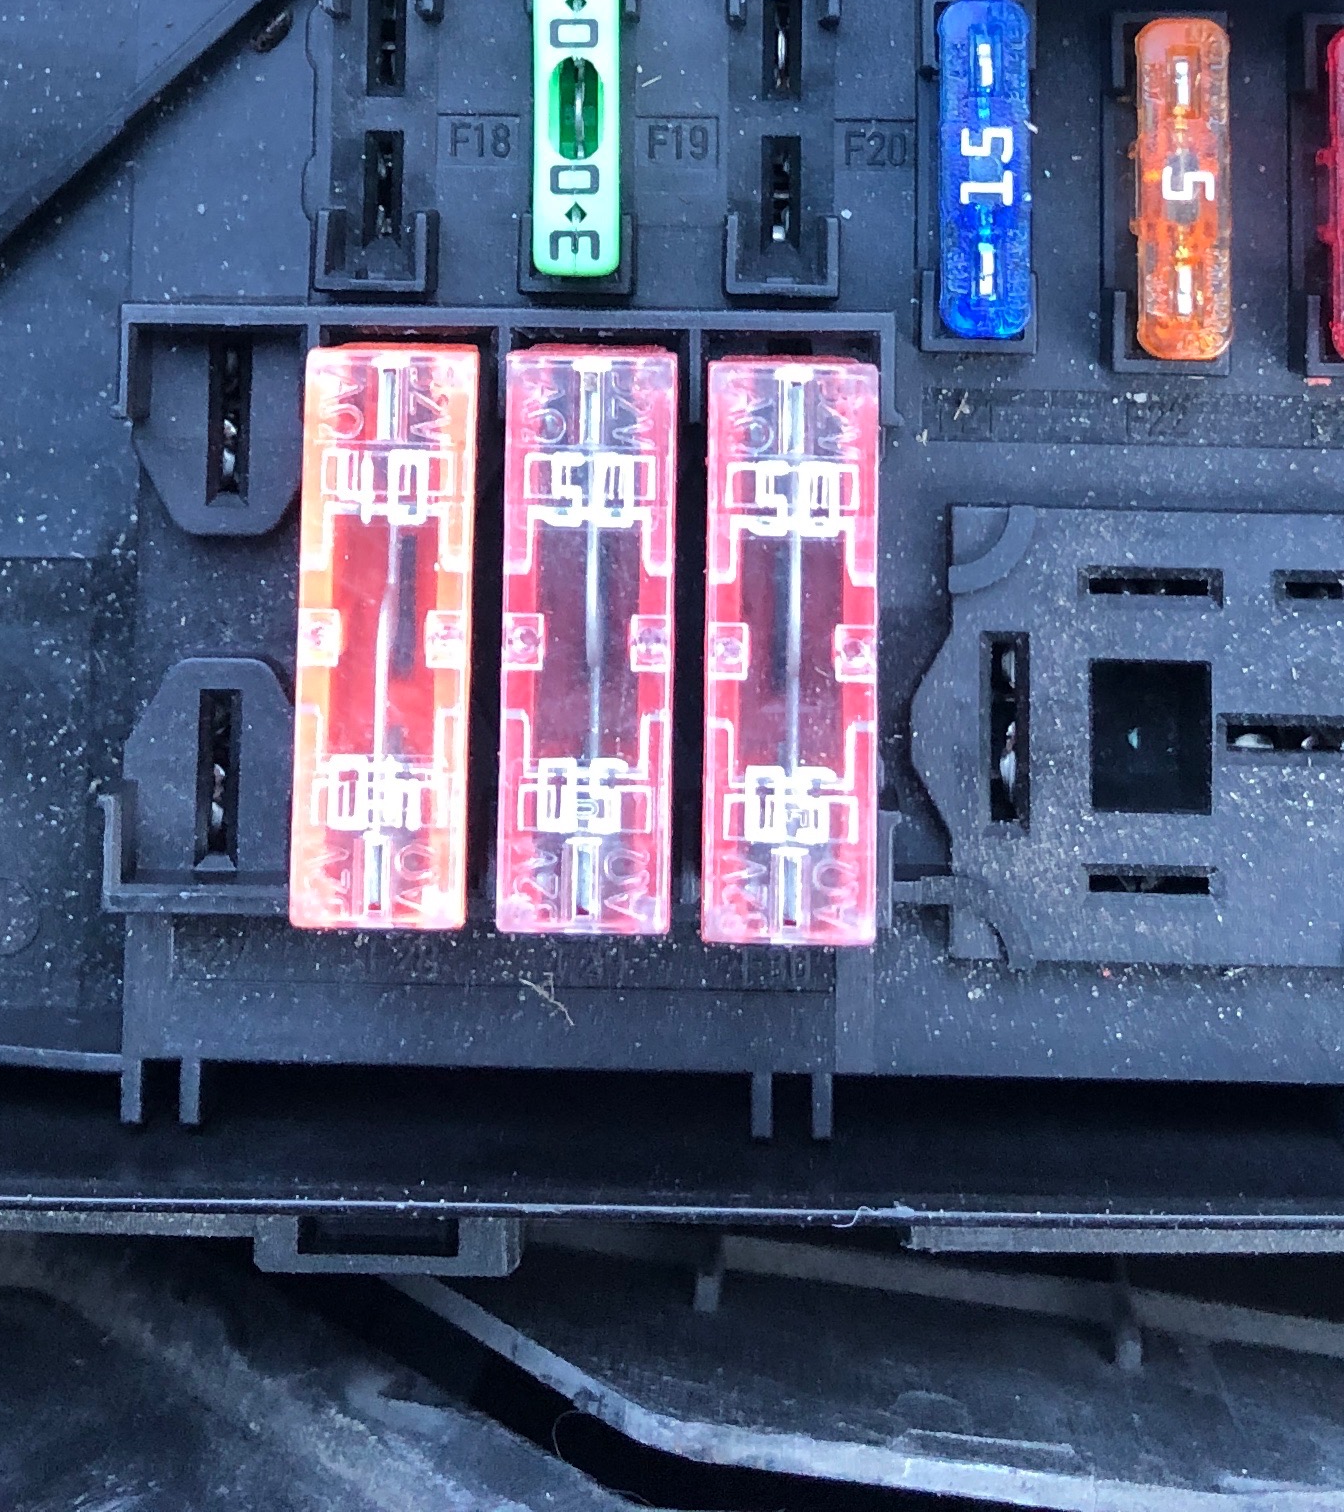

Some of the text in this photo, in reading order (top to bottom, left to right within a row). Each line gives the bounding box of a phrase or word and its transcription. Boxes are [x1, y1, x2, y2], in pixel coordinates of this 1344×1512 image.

[450, 122, 512, 158] F18
[647, 126, 709, 161] F19
[844, 131, 908, 166] F20
[960, 127, 1013, 206] 15
[1161, 165, 1215, 202] 5
[336, 448, 429, 526] 40
[551, 452, 635, 529] 50
[755, 460, 840, 538] 50
[536, 757, 628, 834] 50
[744, 765, 837, 844] 50
